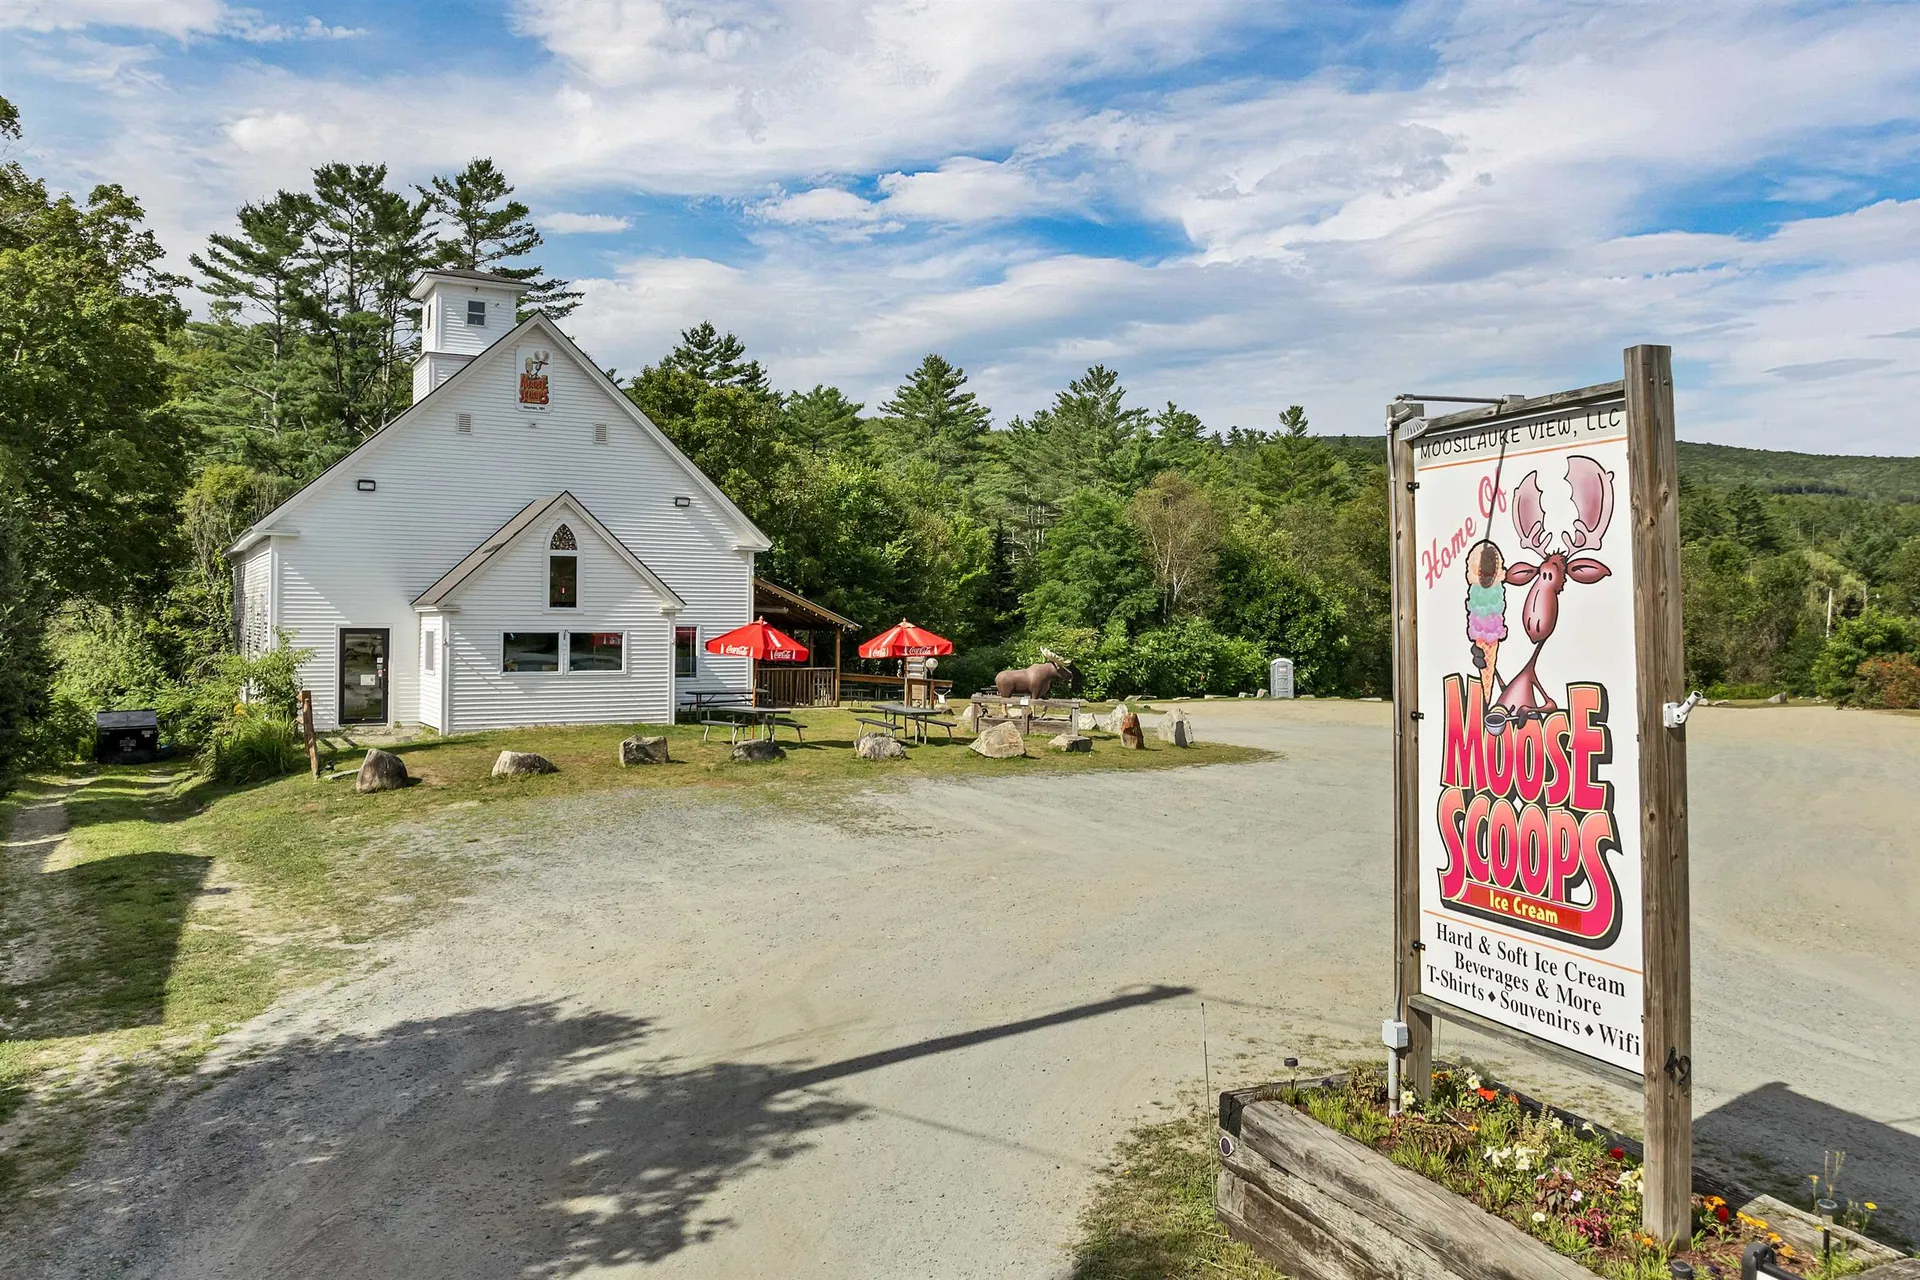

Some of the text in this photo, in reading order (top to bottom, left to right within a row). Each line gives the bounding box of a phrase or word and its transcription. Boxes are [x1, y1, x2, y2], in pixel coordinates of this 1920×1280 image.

[1420, 408, 1621, 459] MOOSILAUKE VIEW, LLC
[1421, 467, 1507, 590] Home Of
[1440, 674, 1613, 812] MOOSE
[1437, 786, 1620, 940] SCOOPS
[1490, 893, 1558, 925] Ice Cream
[1437, 922, 1625, 997] Hard & Soft Ice Cream
[1454, 951, 1601, 1016] Beverages & More
[1427, 965, 1640, 1056] T-Shirts Souvenirs Wifi
